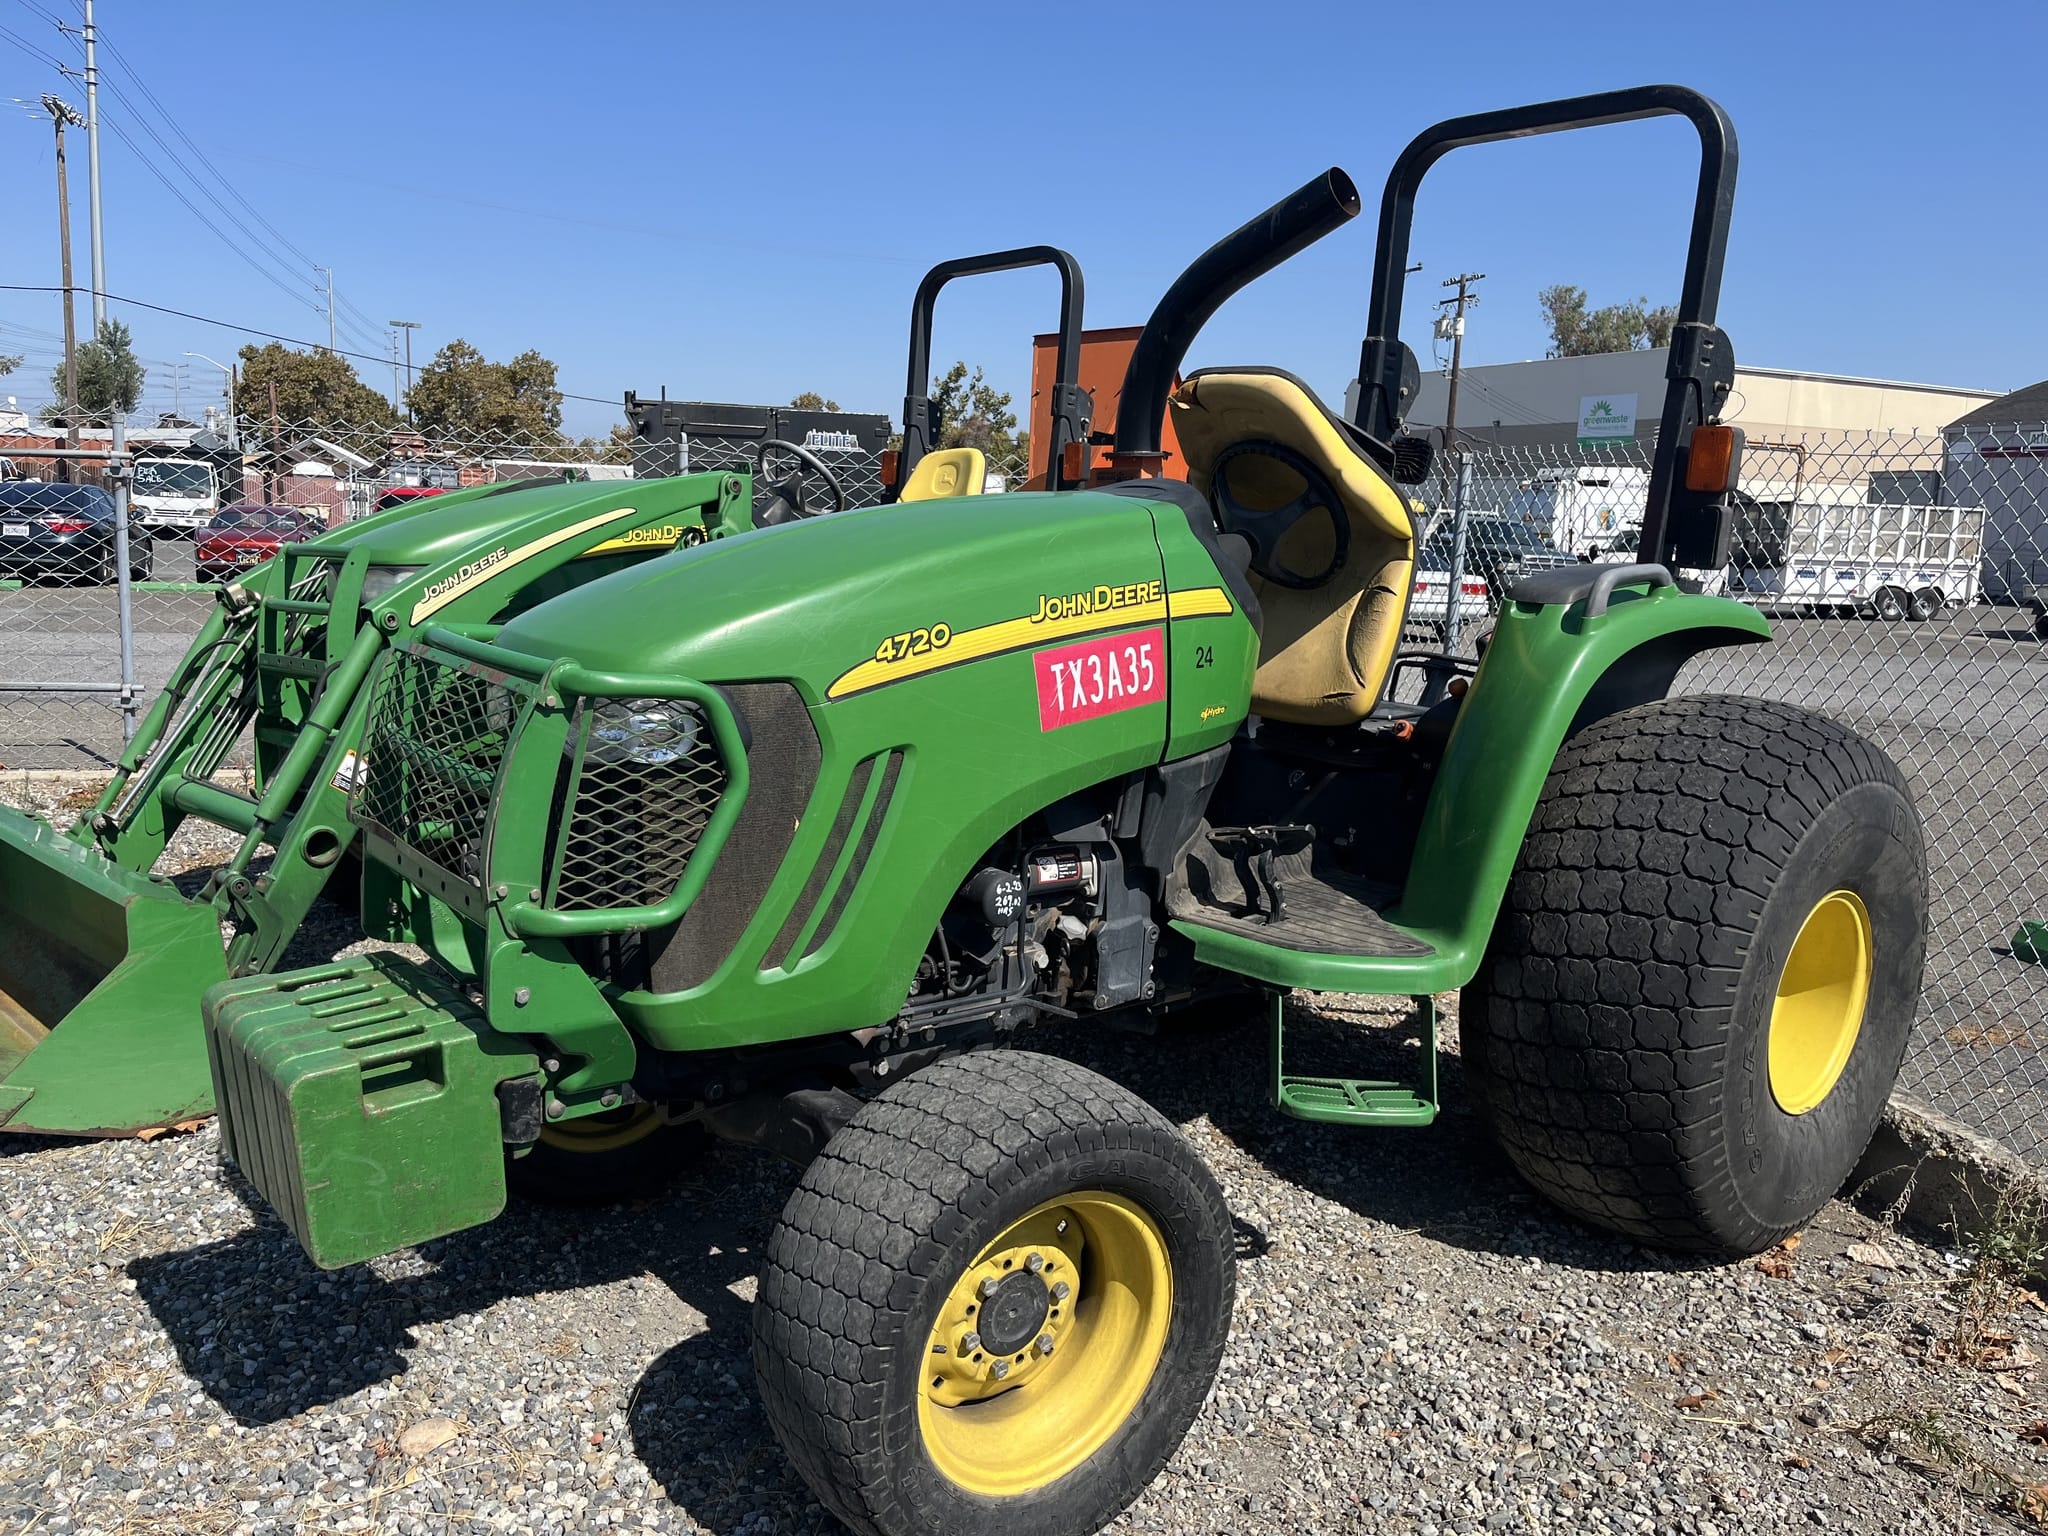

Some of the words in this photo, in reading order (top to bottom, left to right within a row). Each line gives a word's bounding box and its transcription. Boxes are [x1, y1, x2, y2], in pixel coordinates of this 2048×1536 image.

[1583, 414, 1628, 427] greenwaste
[811, 434, 851, 447] ELITE
[137, 475, 161, 483] SALE
[623, 528, 661, 542] JOHN
[421, 573, 460, 603] JOHN
[459, 546, 508, 582] DEERE
[1031, 591, 1092, 623] JOHN
[1094, 579, 1161, 612] DEERE
[875, 623, 951, 662] 4720
[1195, 646, 1214, 669] 24
[1050, 643, 1154, 712] TX3A35
